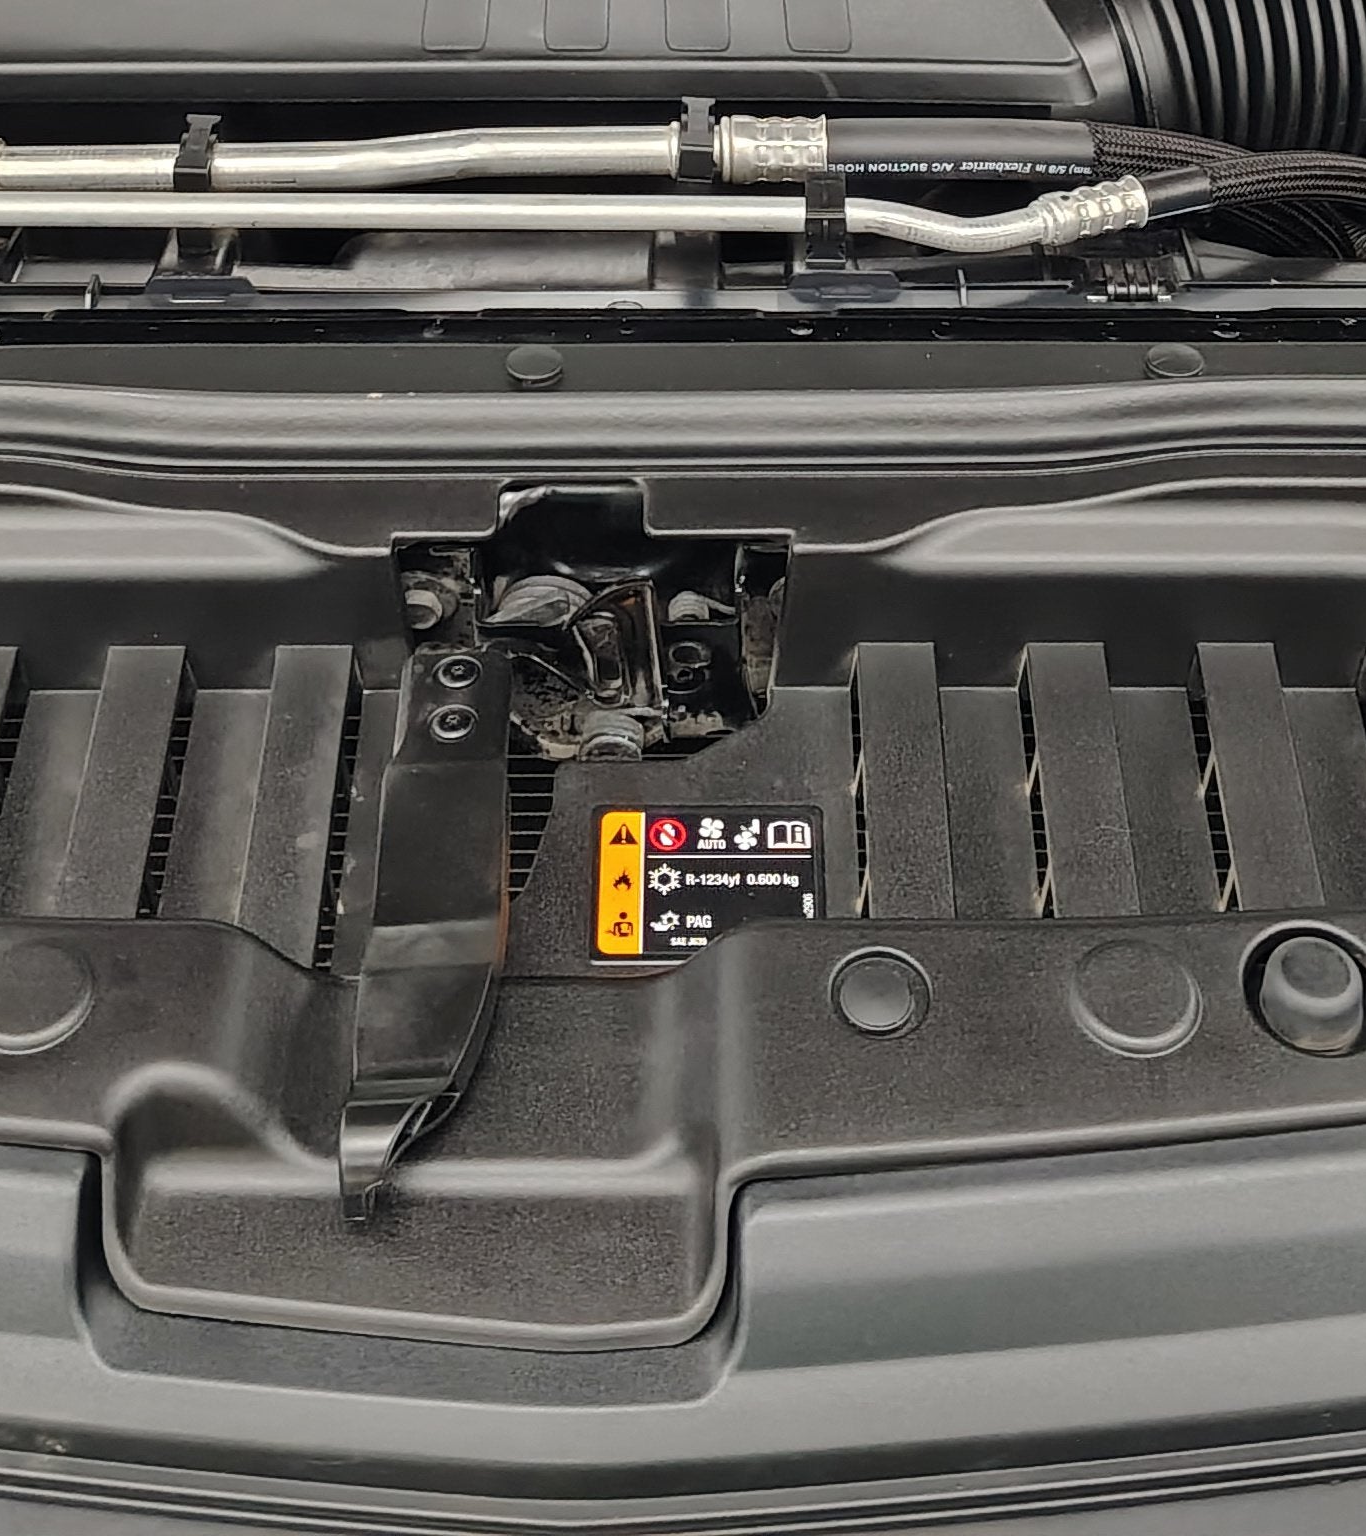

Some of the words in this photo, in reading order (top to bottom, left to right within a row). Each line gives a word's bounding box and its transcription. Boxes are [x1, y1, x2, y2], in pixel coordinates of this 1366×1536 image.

[867, 162, 929, 173] SUCTION
[931, 162, 955, 173] A/C
[959, 161, 1033, 174] Flexbarrier
[696, 839, 727, 850] AUTO
[685, 873, 741, 889] R-1234yf
[746, 873, 781, 886] 0.600
[782, 873, 800, 888] kg
[685, 915, 713, 929] PAG
